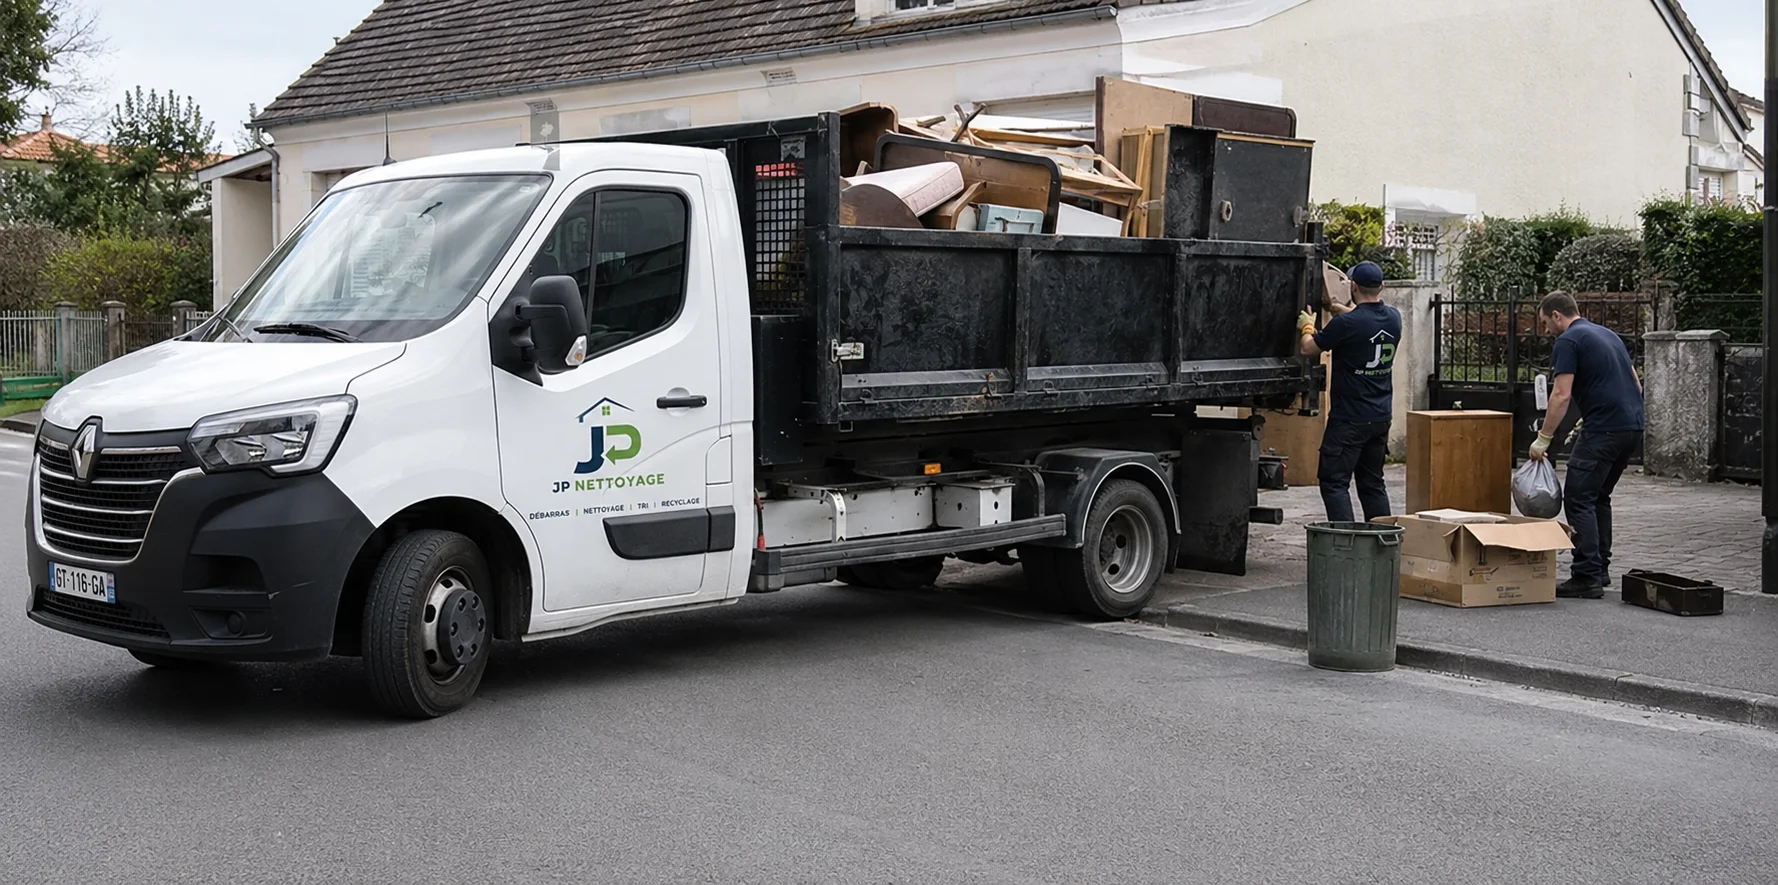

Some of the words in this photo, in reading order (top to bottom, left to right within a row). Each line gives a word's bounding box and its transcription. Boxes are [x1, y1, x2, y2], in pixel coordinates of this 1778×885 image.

[573, 424, 642, 474] JP
[552, 481, 570, 493] JP
[575, 473, 665, 491] NETTOYAGE
[529, 509, 570, 520] DÉBARRAS
[583, 504, 625, 514] NETTOYAGE
[55, 567, 106, 597] GT-116-GA
